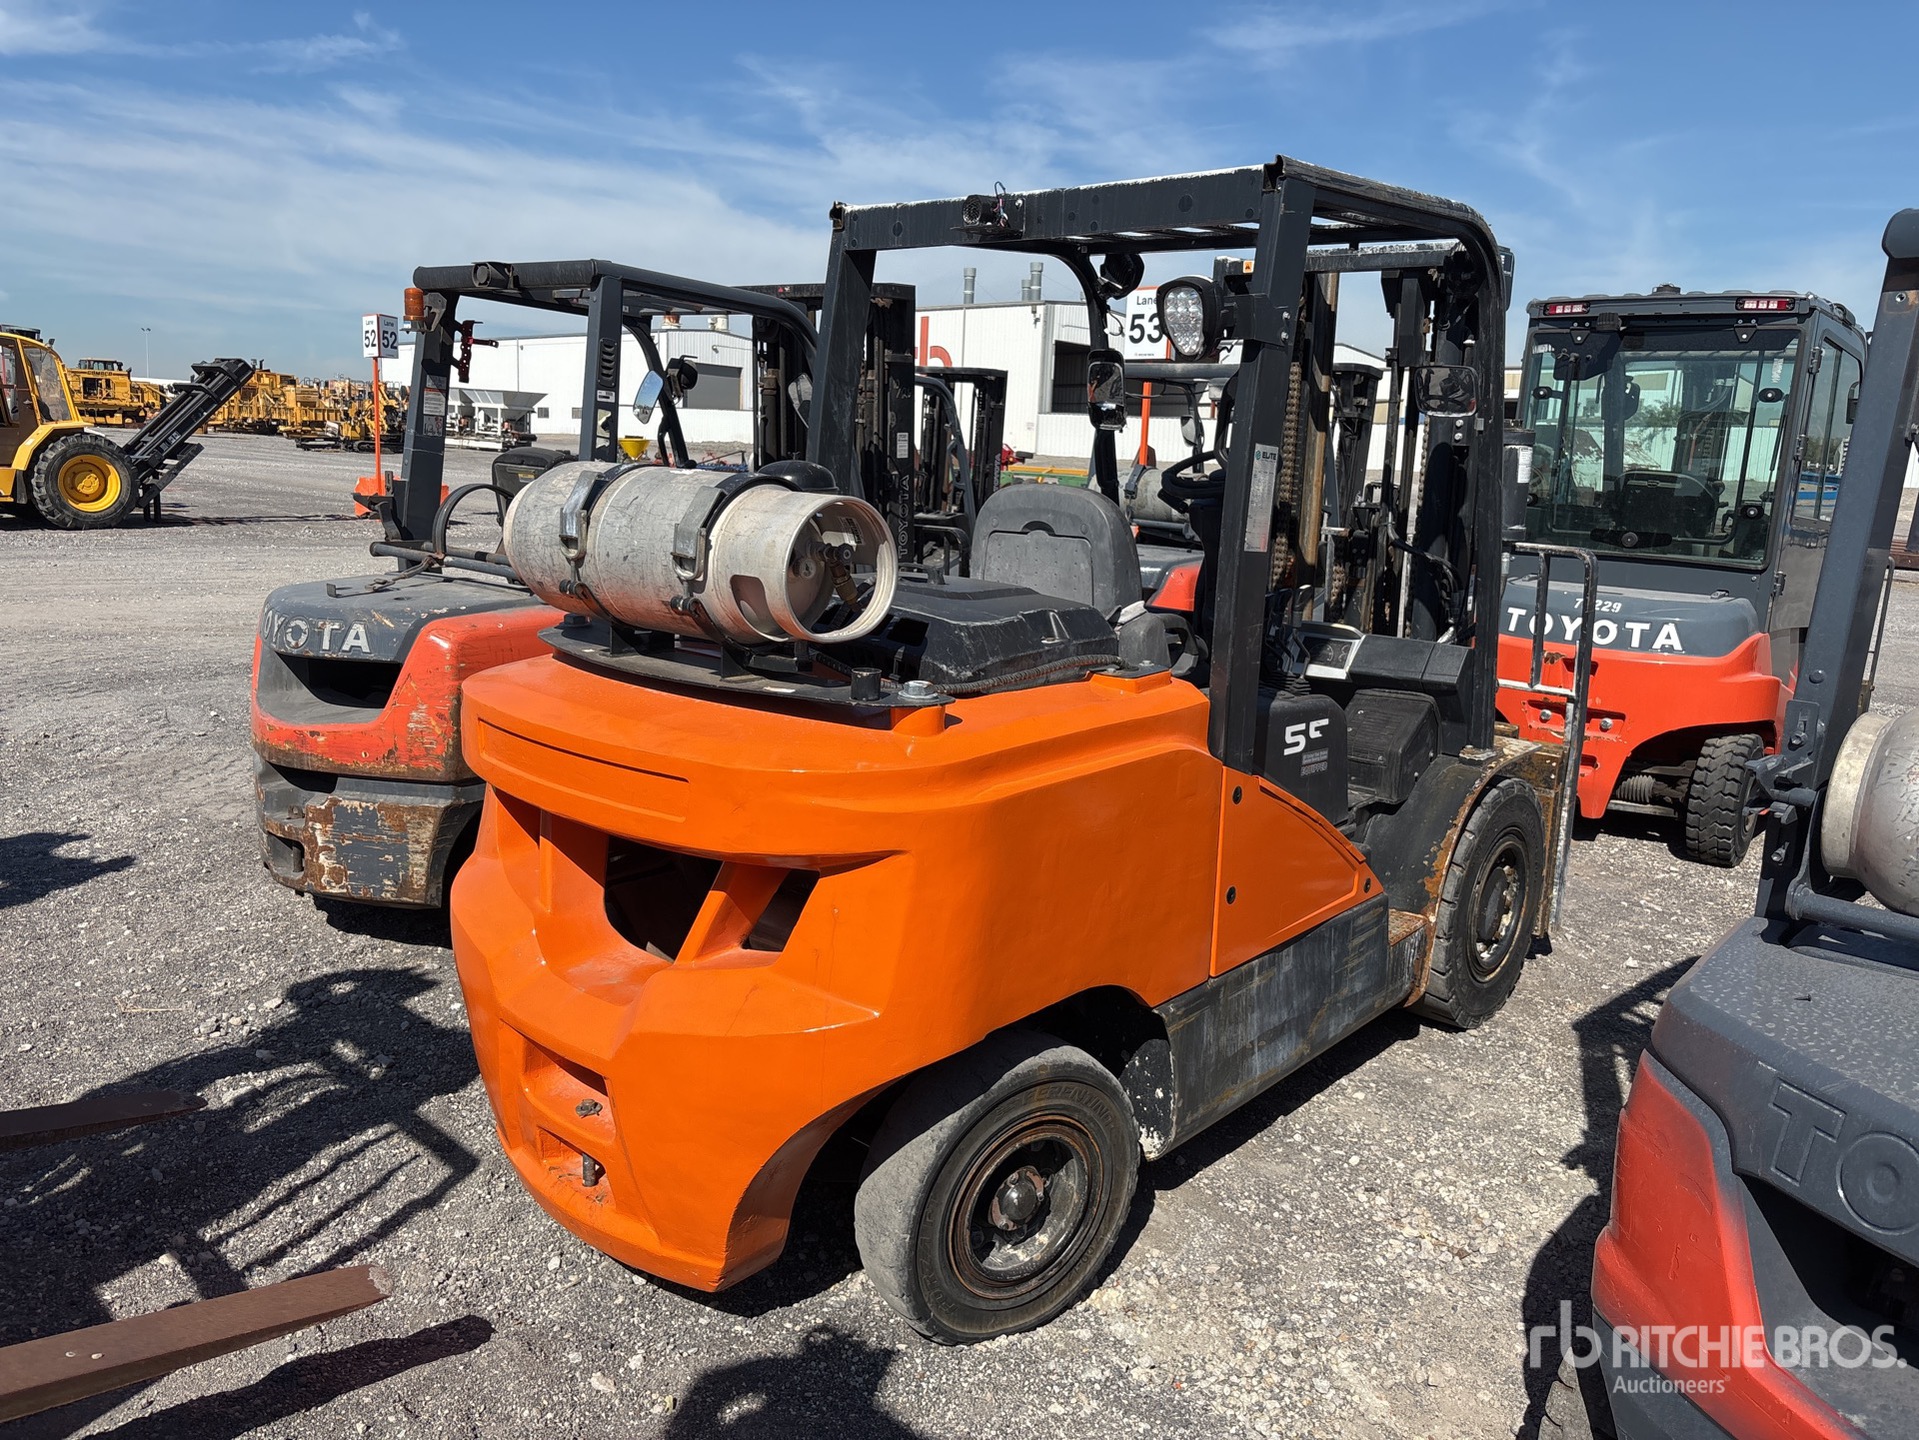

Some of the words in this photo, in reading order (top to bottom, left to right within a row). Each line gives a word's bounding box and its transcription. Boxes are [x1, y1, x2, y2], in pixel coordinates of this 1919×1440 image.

[1136, 296, 1157, 306] Lane
[364, 329, 377, 348] 52
[382, 330, 398, 350] 52
[1129, 314, 1163, 344] 53
[898, 474, 910, 559] TOYOTA
[1573, 598, 1623, 614] 7229
[263, 609, 372, 654] OYOTA
[1506, 607, 1684, 652] TOYOTA
